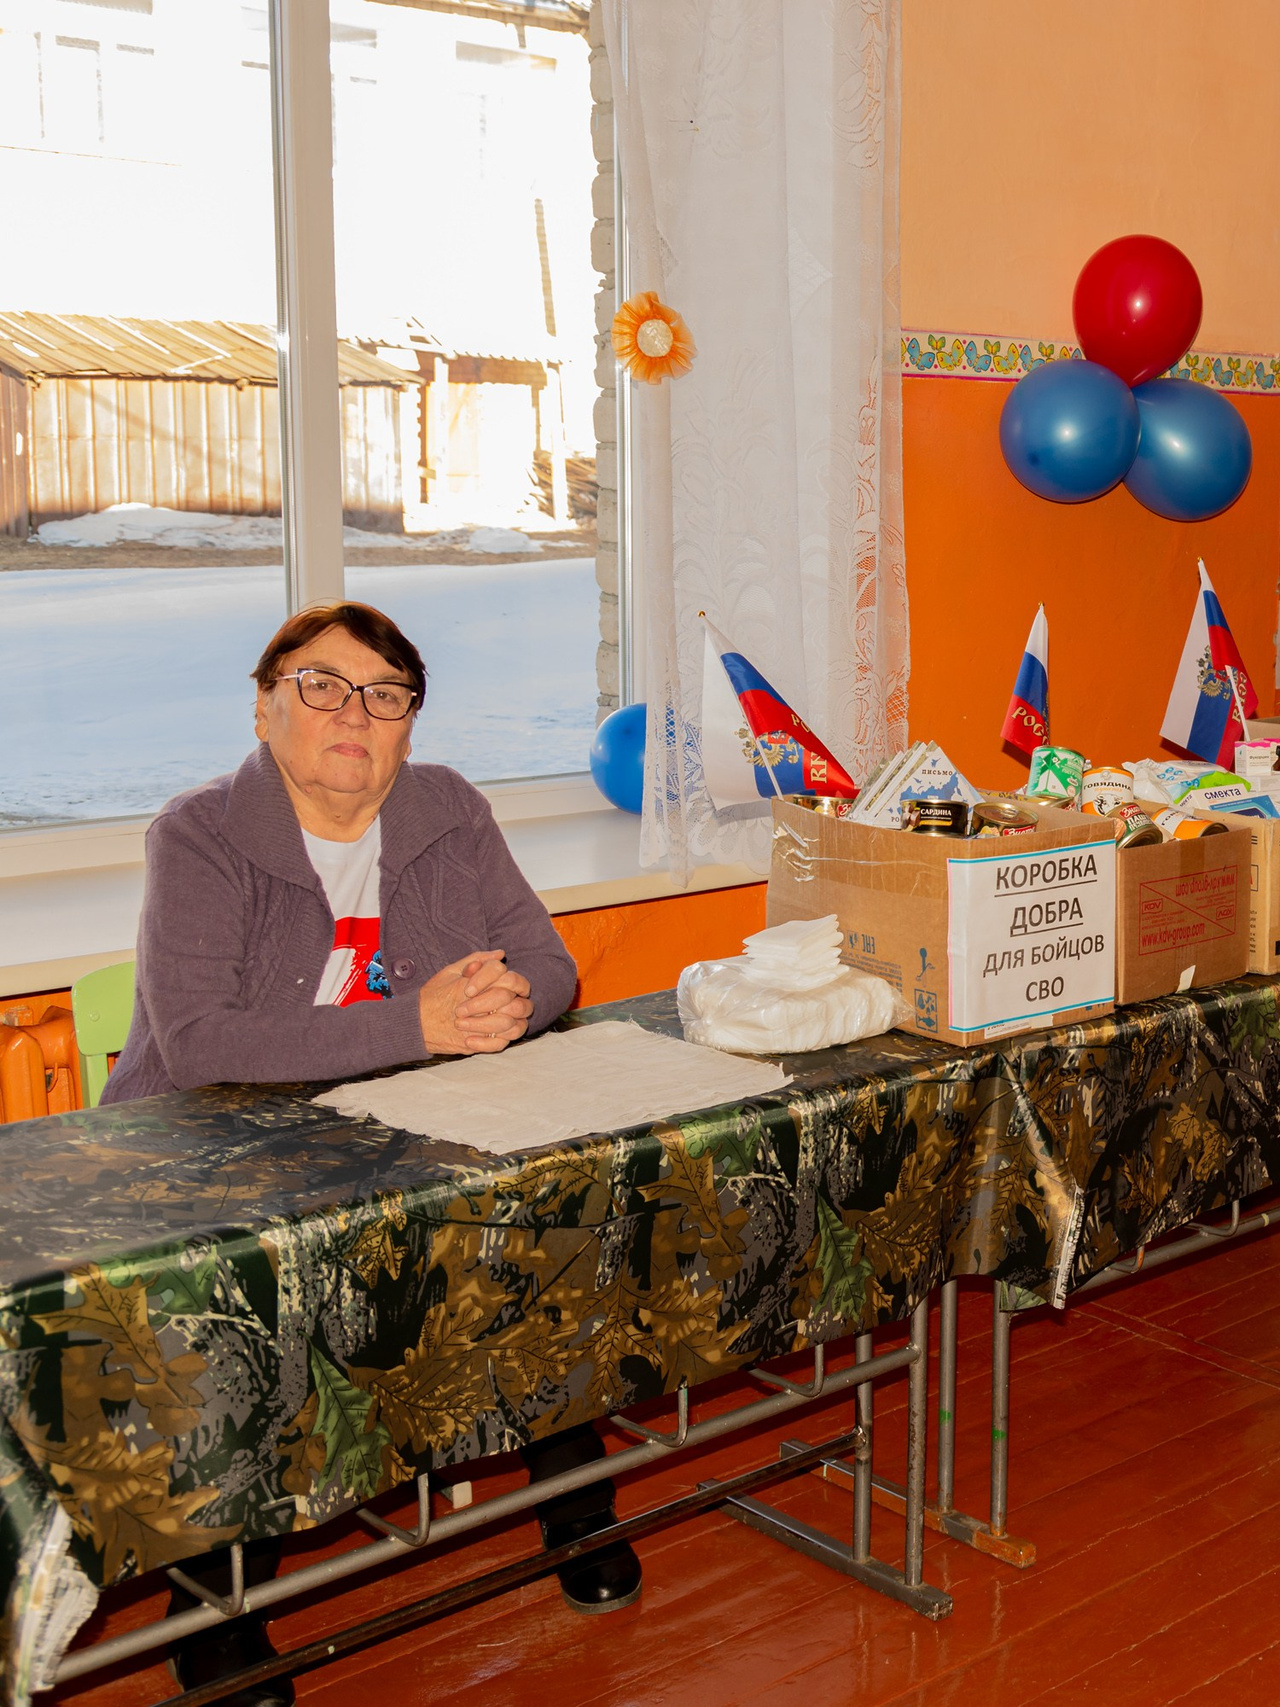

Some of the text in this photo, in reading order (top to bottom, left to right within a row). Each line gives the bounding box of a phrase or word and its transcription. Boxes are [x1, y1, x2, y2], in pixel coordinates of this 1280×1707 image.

[920, 808, 952, 816] САРДИНА
[996, 854, 1098, 891] КОРОБКА
[1010, 897, 1083, 936] ДОБРА
[983, 934, 1105, 978] ДЛЯ БОЙЦОВ
[1025, 976, 1064, 1002] СВО
